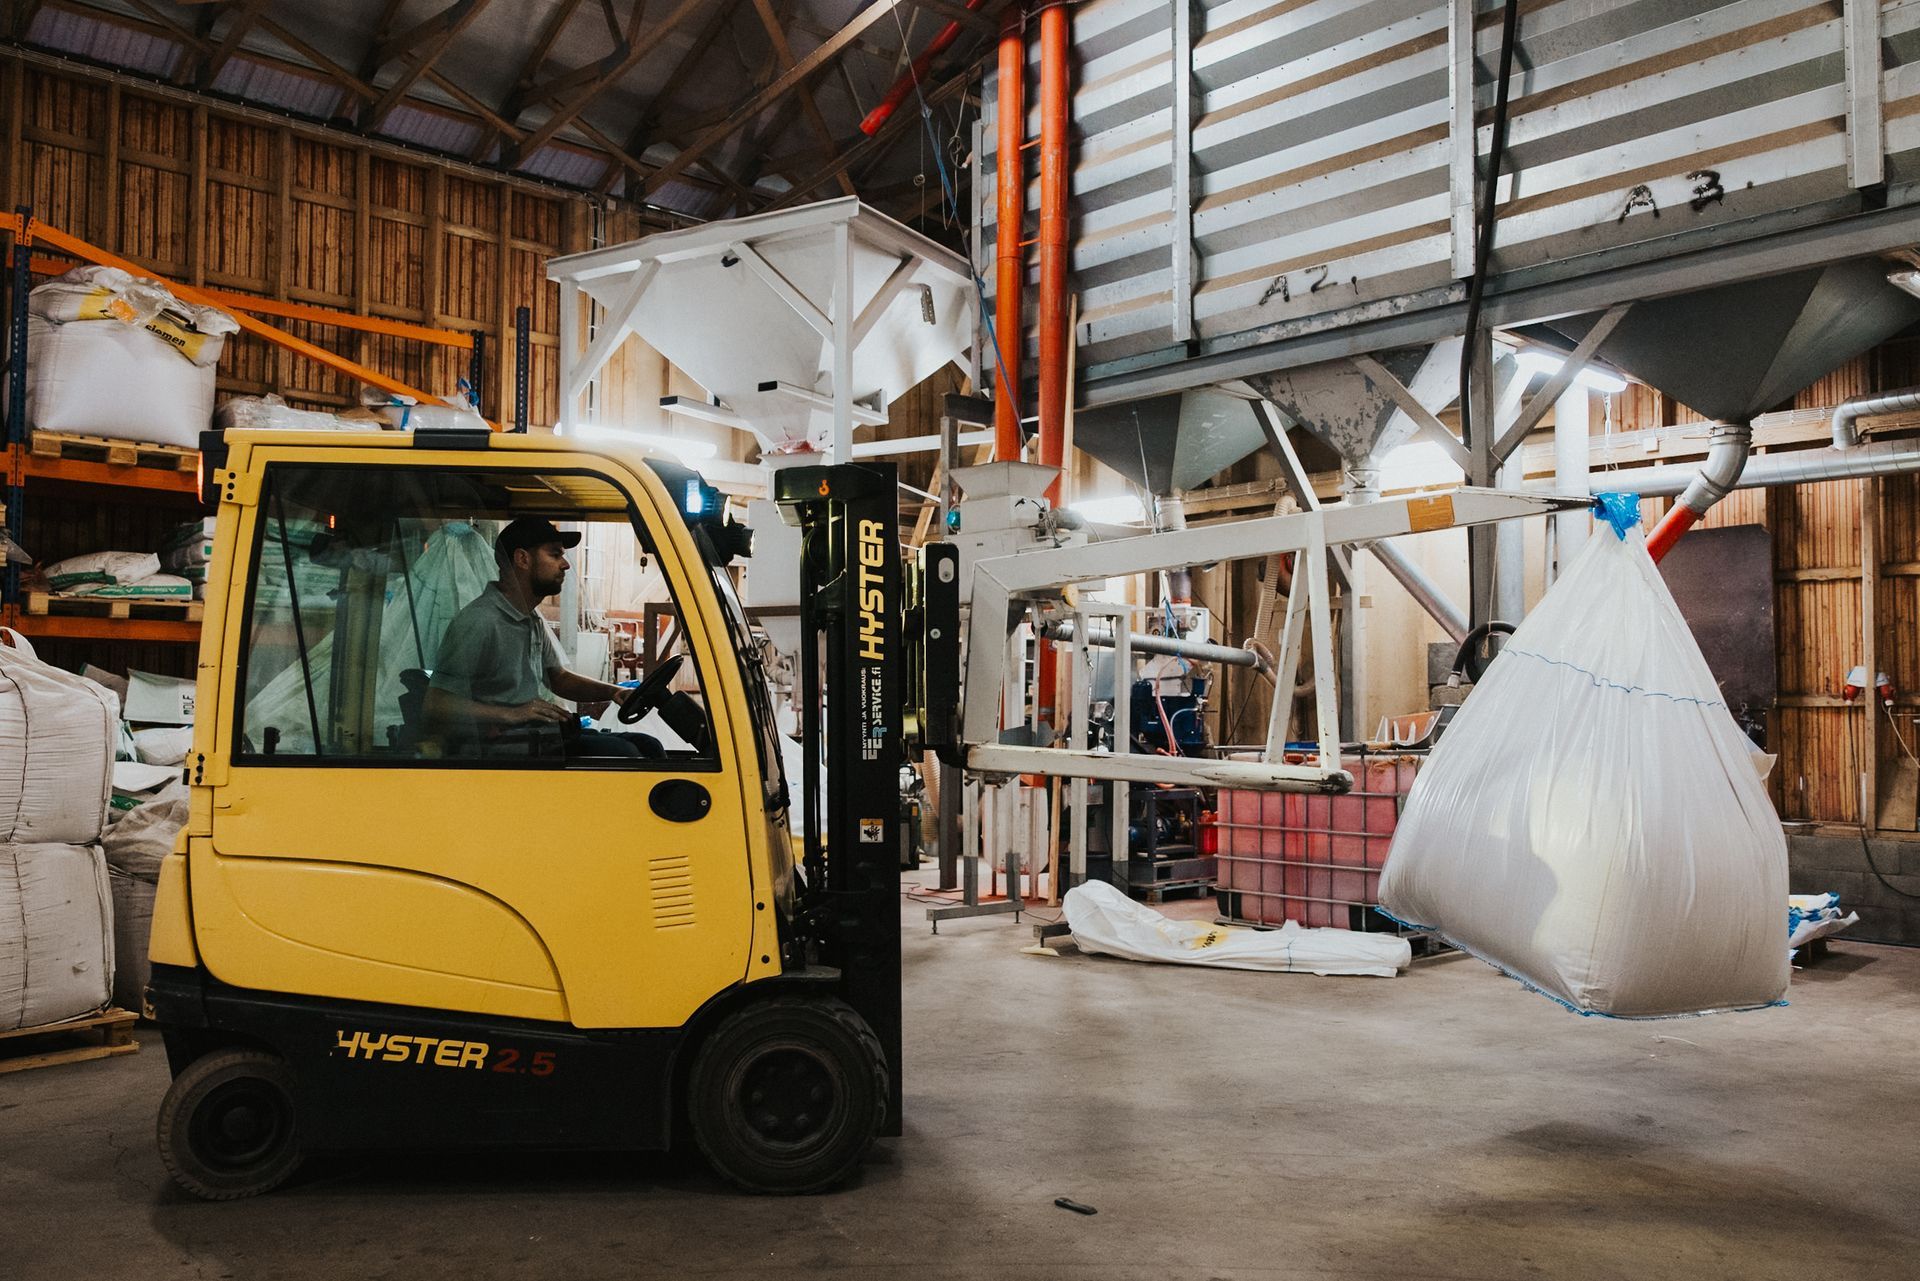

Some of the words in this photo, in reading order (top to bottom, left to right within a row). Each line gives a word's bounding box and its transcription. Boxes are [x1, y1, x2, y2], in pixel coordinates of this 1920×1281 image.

[859, 519, 884, 660] HYSTER
[861, 711, 867, 720] JA
[336, 1030, 490, 1070] HYSTER
[492, 1048, 557, 1077] 2.5
